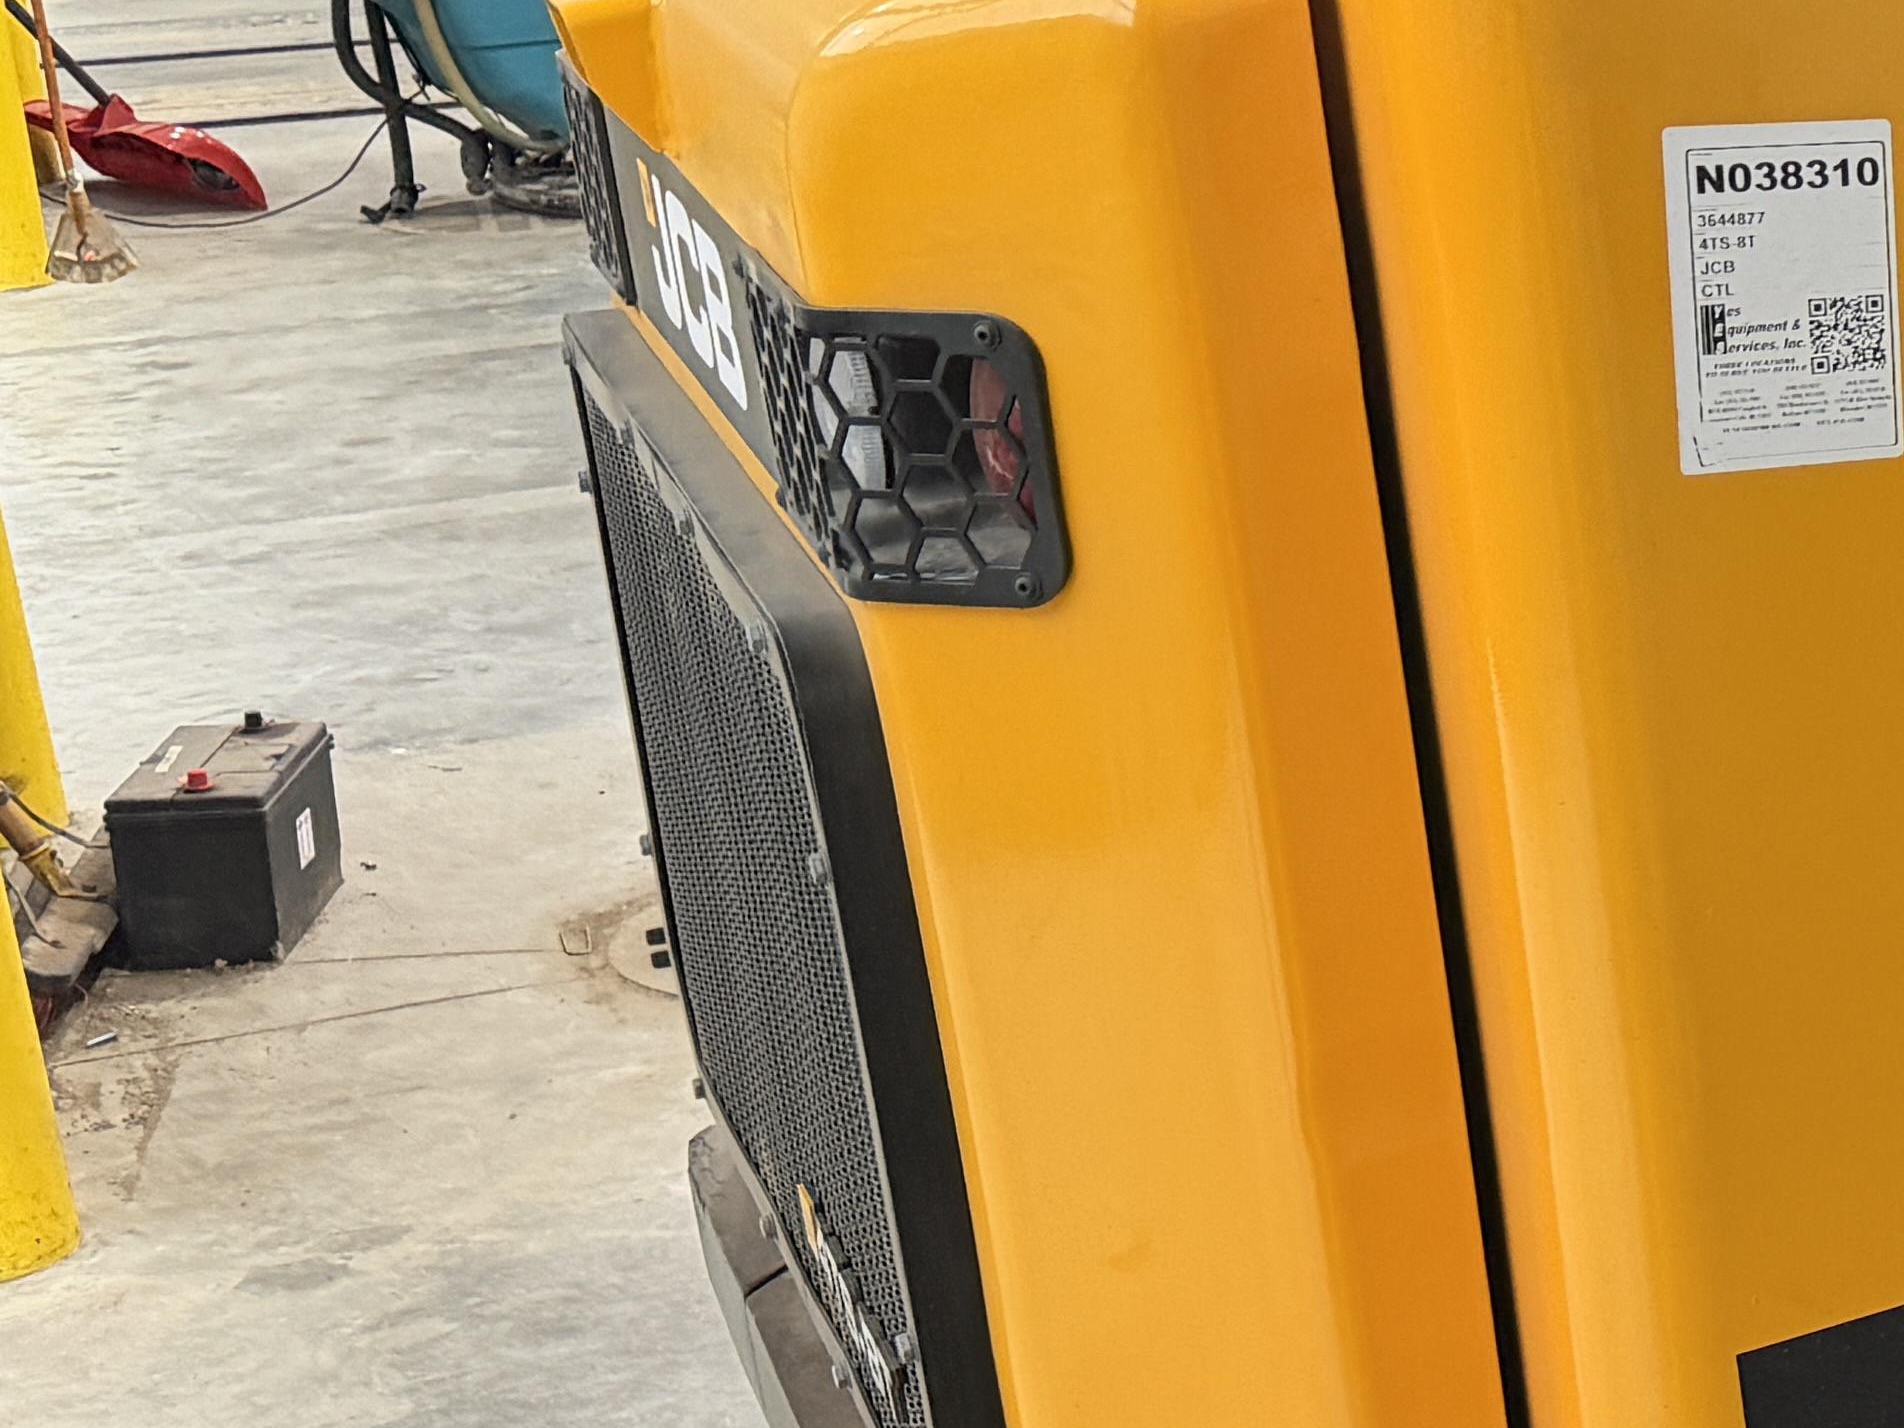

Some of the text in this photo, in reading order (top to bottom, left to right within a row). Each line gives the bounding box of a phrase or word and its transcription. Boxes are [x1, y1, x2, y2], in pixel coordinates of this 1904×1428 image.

[1696, 157, 1880, 194] N038310
[1698, 212, 1766, 227] 3644877
[1699, 235, 1756, 250] 4TS-8T
[1701, 260, 1736, 275] JCB
[651, 174, 748, 411] JCB
[1701, 283, 1735, 298] CTL
[1713, 319, 1801, 338] Equipment &
[1783, 338, 1807, 350] Inc.
